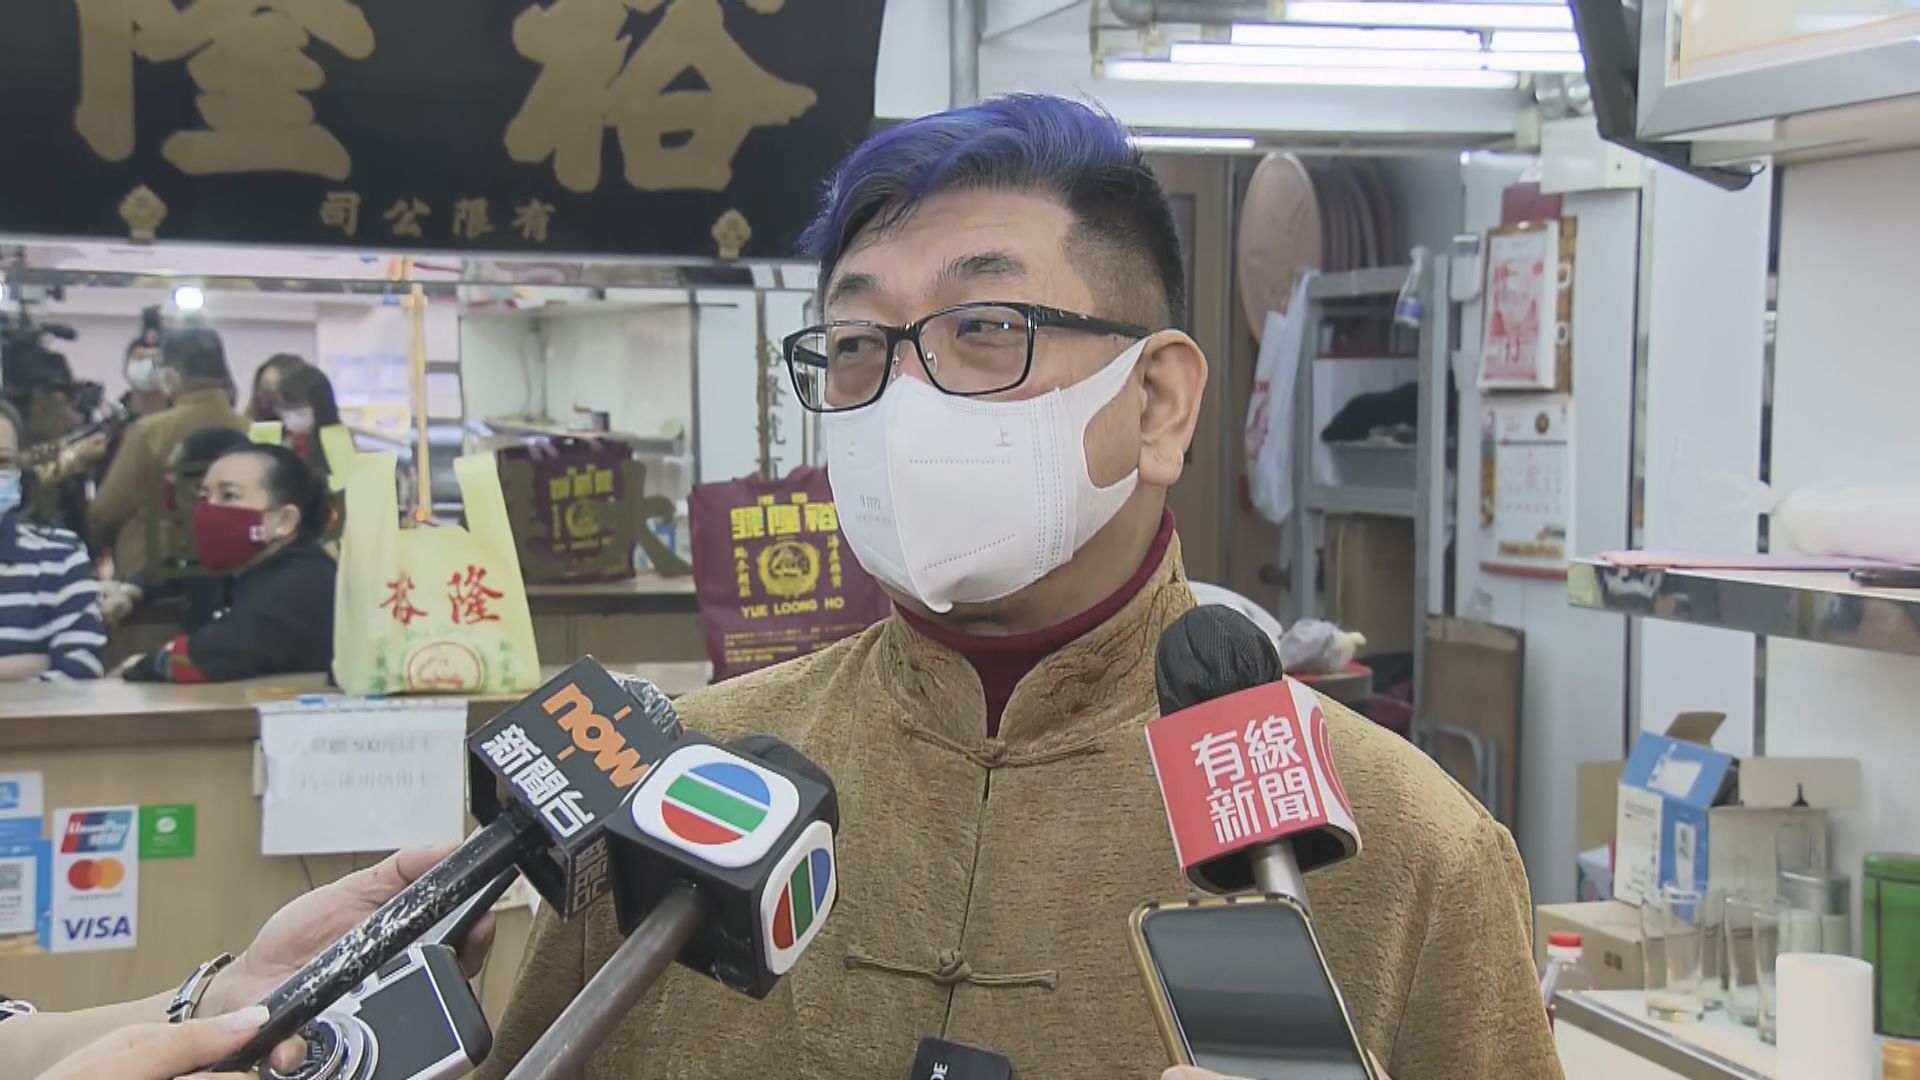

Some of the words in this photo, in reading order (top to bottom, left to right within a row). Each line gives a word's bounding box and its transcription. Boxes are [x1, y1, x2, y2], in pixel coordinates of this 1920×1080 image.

[741, 604, 769, 619] YUE
[773, 599, 819, 616] LOONG
[824, 596, 845, 610] HO
[541, 681, 652, 791] now
[1191, 714, 1304, 788] 有線
[480, 722, 596, 839] 新聞台
[1206, 766, 1321, 844] 新聞
[63, 916, 131, 940] VISA
